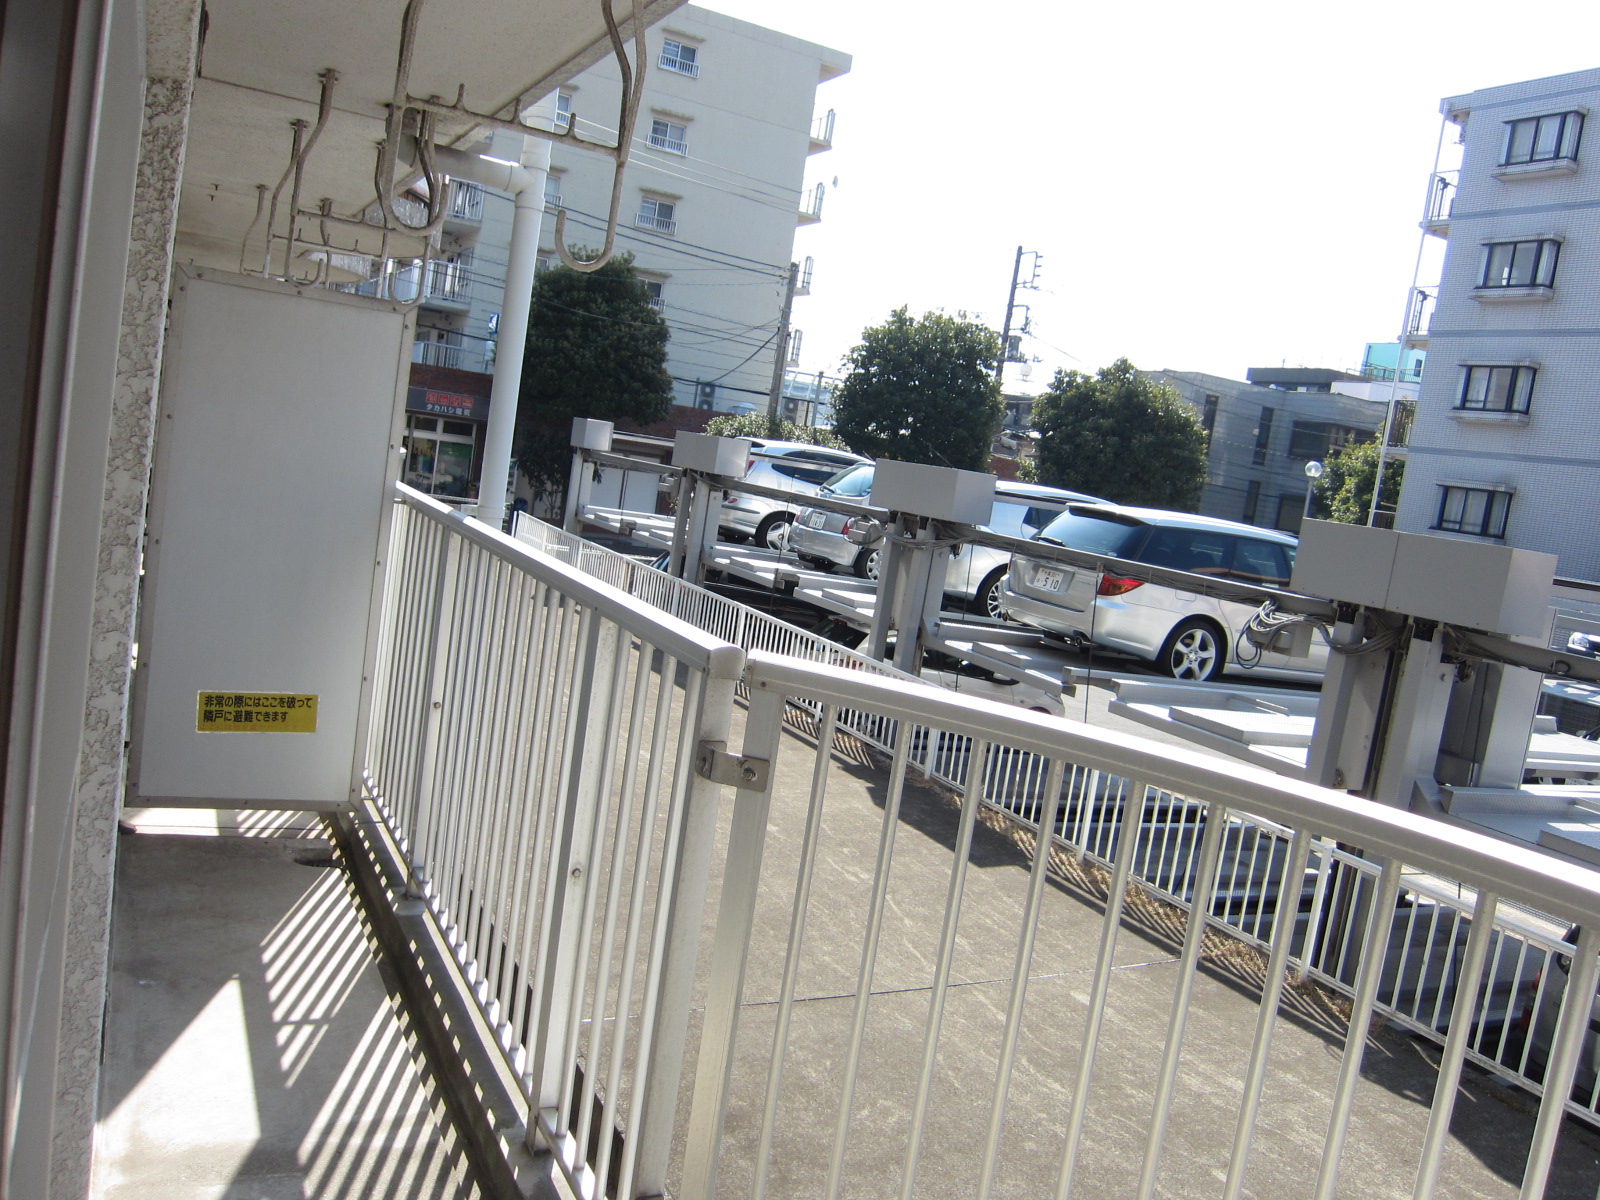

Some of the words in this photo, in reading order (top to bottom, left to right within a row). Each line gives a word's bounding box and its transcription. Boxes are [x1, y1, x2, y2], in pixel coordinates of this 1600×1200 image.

[204, 695, 313, 708] 非常の際にはここを破って
[203, 709, 289, 722] 隣戸に避難できます
